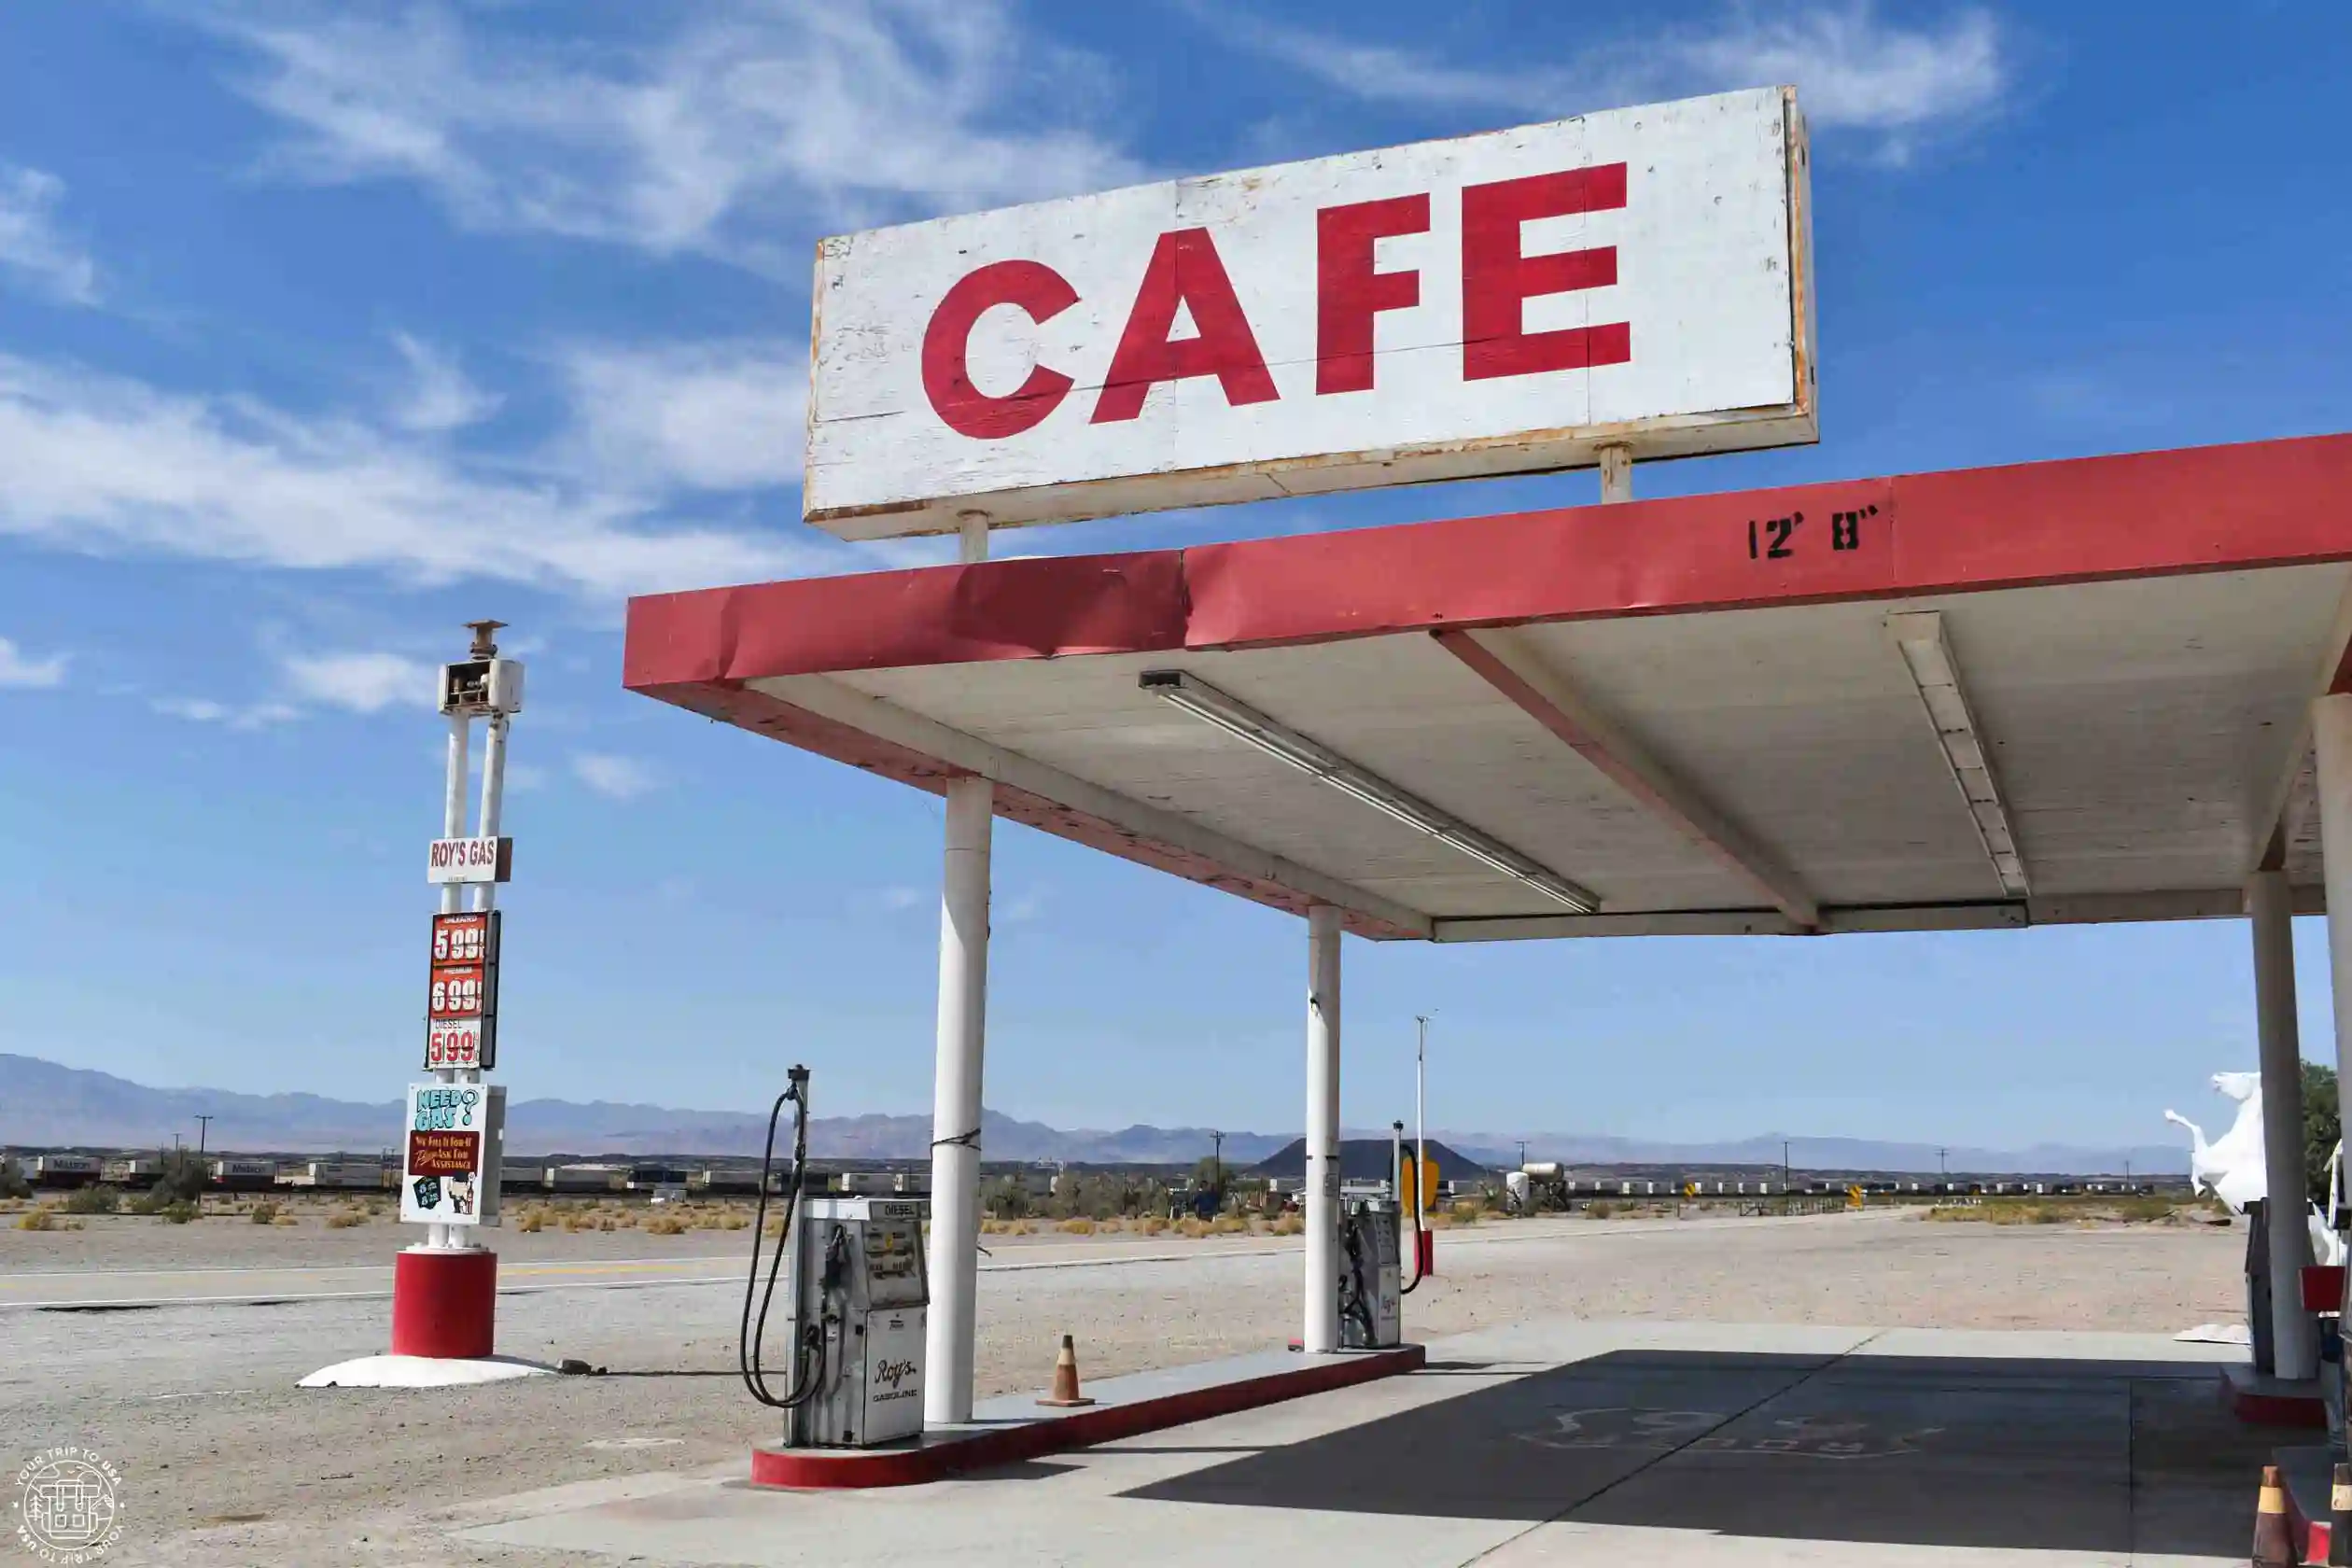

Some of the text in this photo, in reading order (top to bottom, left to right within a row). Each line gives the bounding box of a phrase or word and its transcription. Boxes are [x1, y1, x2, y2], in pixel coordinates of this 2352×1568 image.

[920, 161, 1631, 440] CAFE
[431, 839, 495, 868] ROY'S GAS
[435, 1018, 463, 1029] DIESEL
[873, 1389, 917, 1403] GASOLINE
